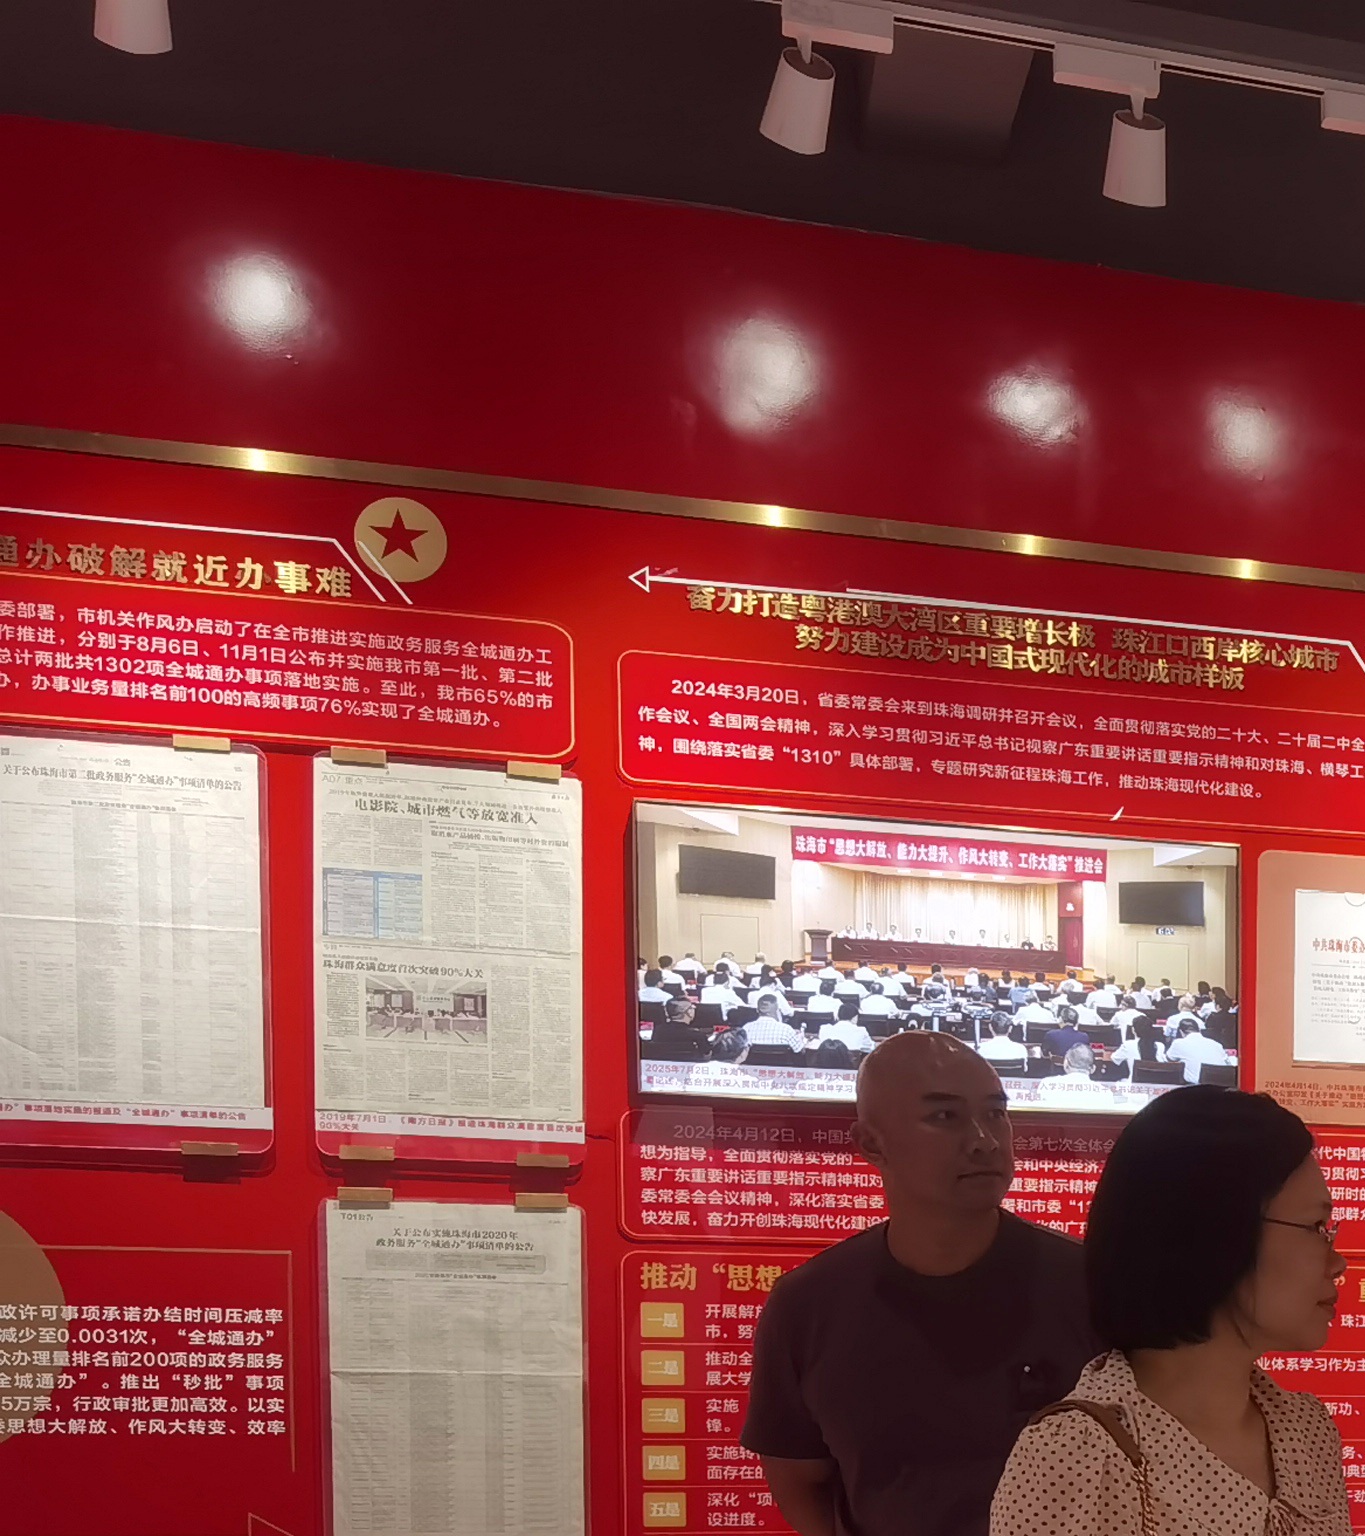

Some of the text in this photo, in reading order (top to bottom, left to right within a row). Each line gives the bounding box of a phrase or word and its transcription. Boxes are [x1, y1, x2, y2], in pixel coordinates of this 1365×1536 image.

[686, 585, 1340, 673] 奋力打造粤港澳大湾区重要增长极 珠江口西岸核心城市
[795, 623, 1245, 692] 努力建设成为中国式现代化的城市样板
[354, 798, 539, 825] 电影院、城市燃气等放宽准入
[640, 1166, 883, 1189] 察广东重要讲话重要指示精神和对
[641, 1189, 885, 1210] 委常委会会议精神，深化落实省委
[641, 1210, 891, 1231] 快发展，奋力开创珠海现代化建设
[0, 1304, 284, 1325] 政许可事项承诺办结时间压减率
[705, 1324, 757, 1340] 市，努
[705, 1351, 754, 1367] 推动全
[706, 1398, 740, 1414] 实施
[0, 1418, 286, 1436] 思想大解放、作风大转变、效率
[707, 1512, 766, 1527] 设进度。
